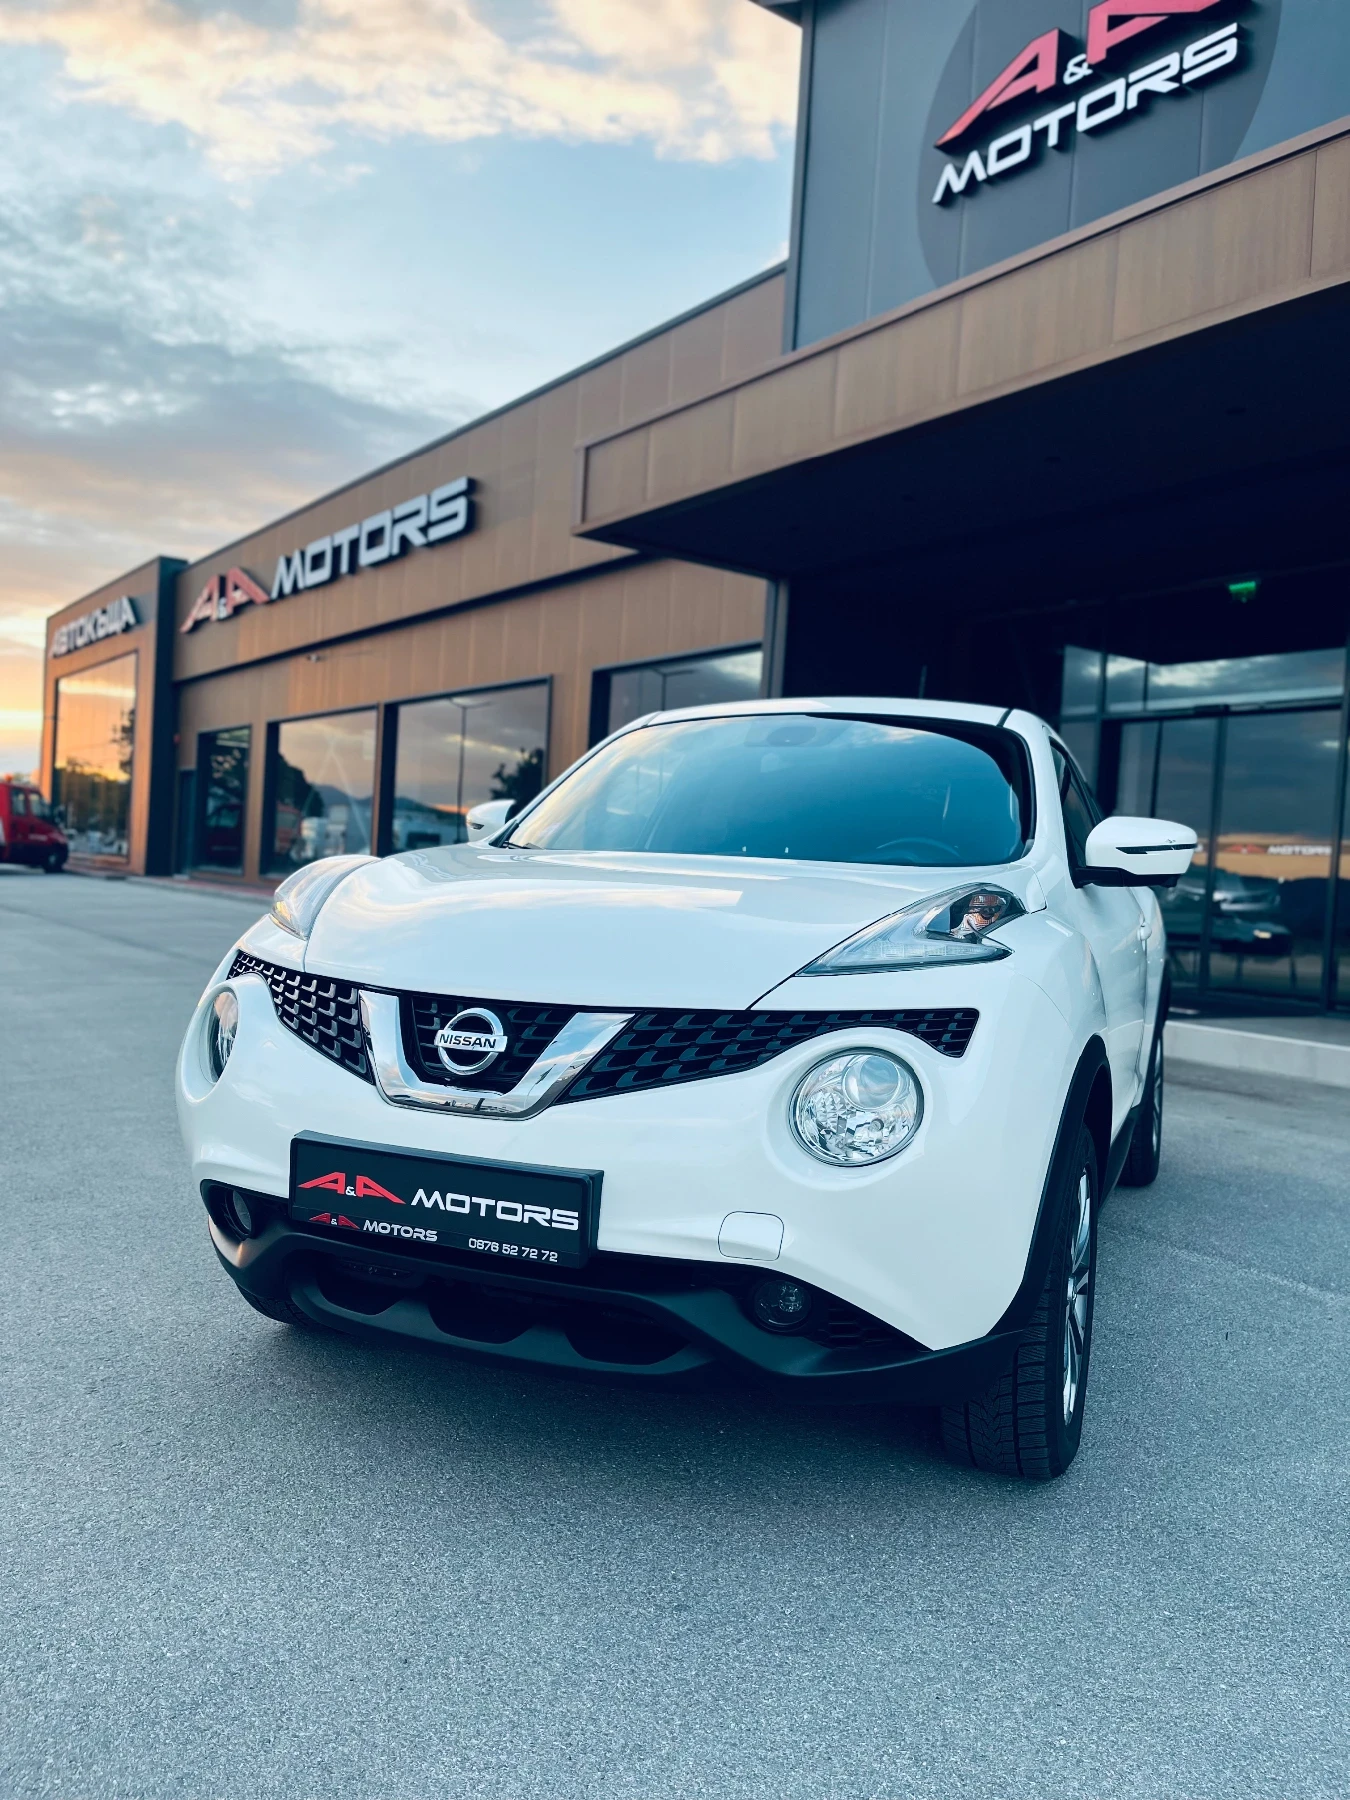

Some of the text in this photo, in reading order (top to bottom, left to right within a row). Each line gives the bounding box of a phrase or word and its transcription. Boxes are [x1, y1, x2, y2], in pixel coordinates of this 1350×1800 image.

[932, 23, 1238, 203] MOTORS
[271, 477, 469, 599] MOTORS
[440, 1034, 496, 1048] NISSAN
[298, 1171, 579, 1231] A&A MOTORS
[309, 1212, 438, 1242] A&A MOTORS
[502, 1243, 518, 1255] 52
[521, 1246, 538, 1259] 72
[541, 1249, 558, 1262] 72
